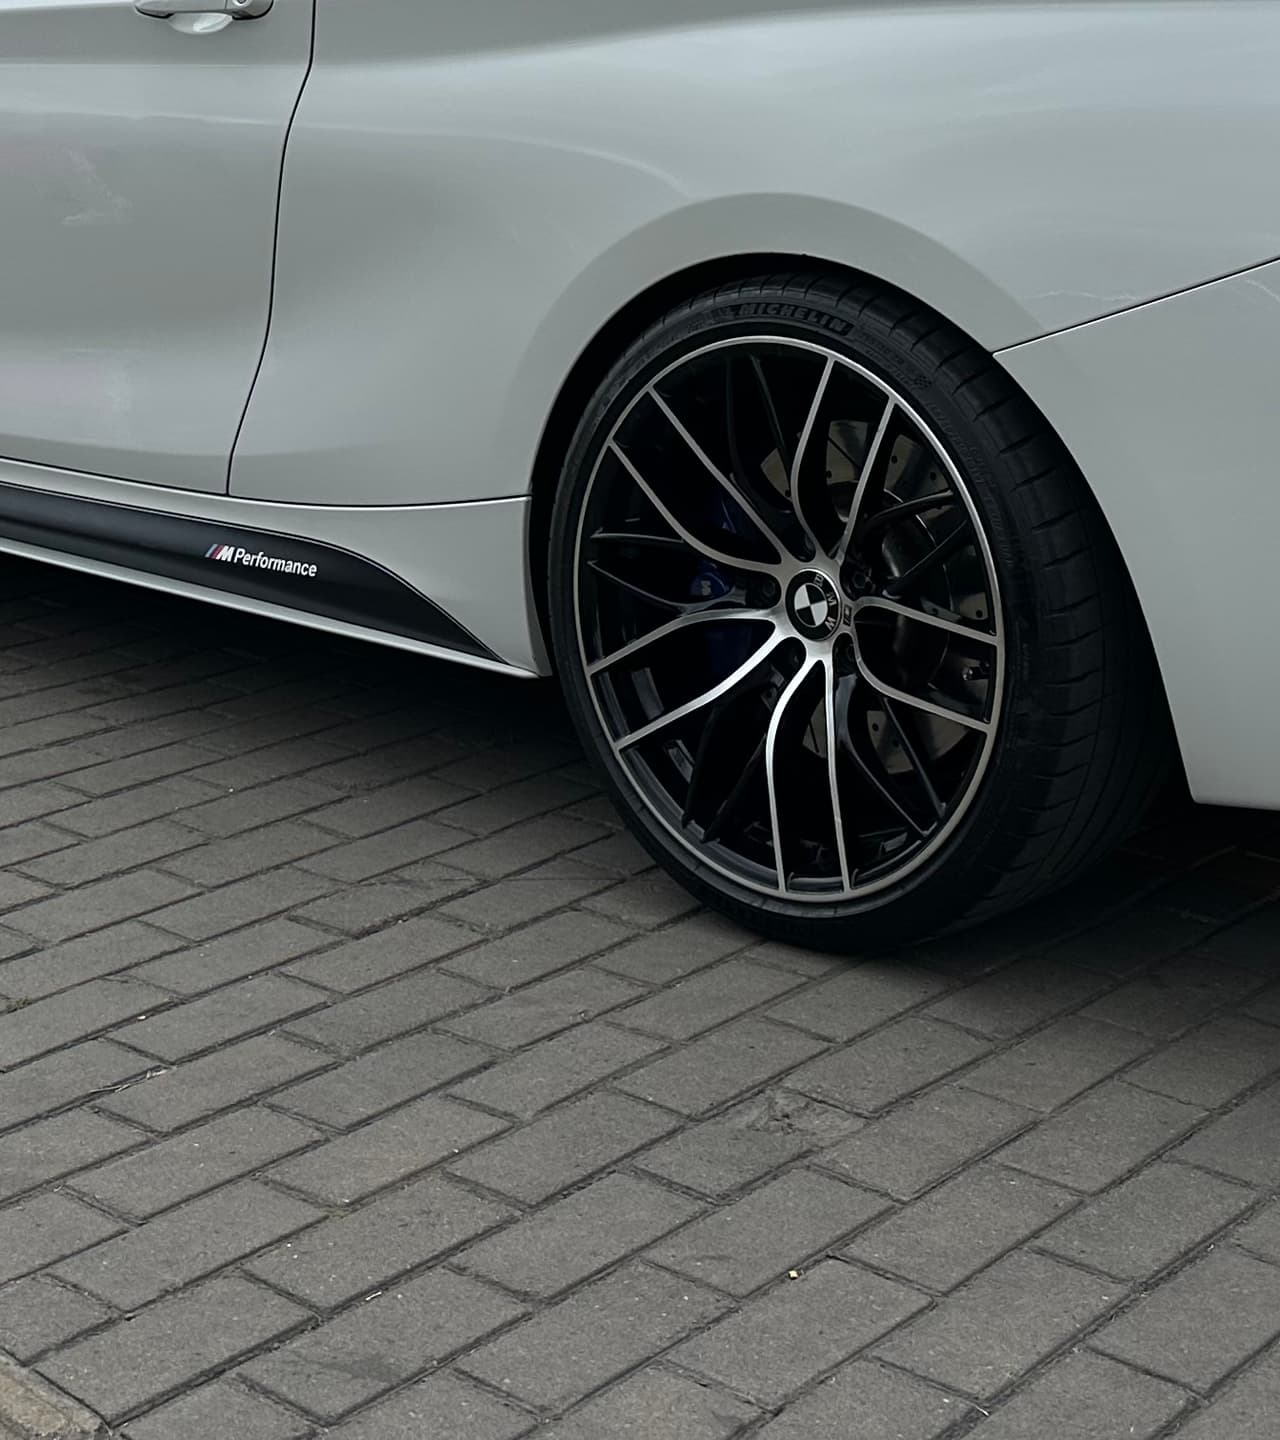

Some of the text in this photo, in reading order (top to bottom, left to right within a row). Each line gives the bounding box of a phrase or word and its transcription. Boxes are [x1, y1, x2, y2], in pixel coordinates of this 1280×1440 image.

[738, 303, 848, 332] MICHELIN
[234, 548, 317, 577] Performance
[814, 573, 837, 631] BMW
